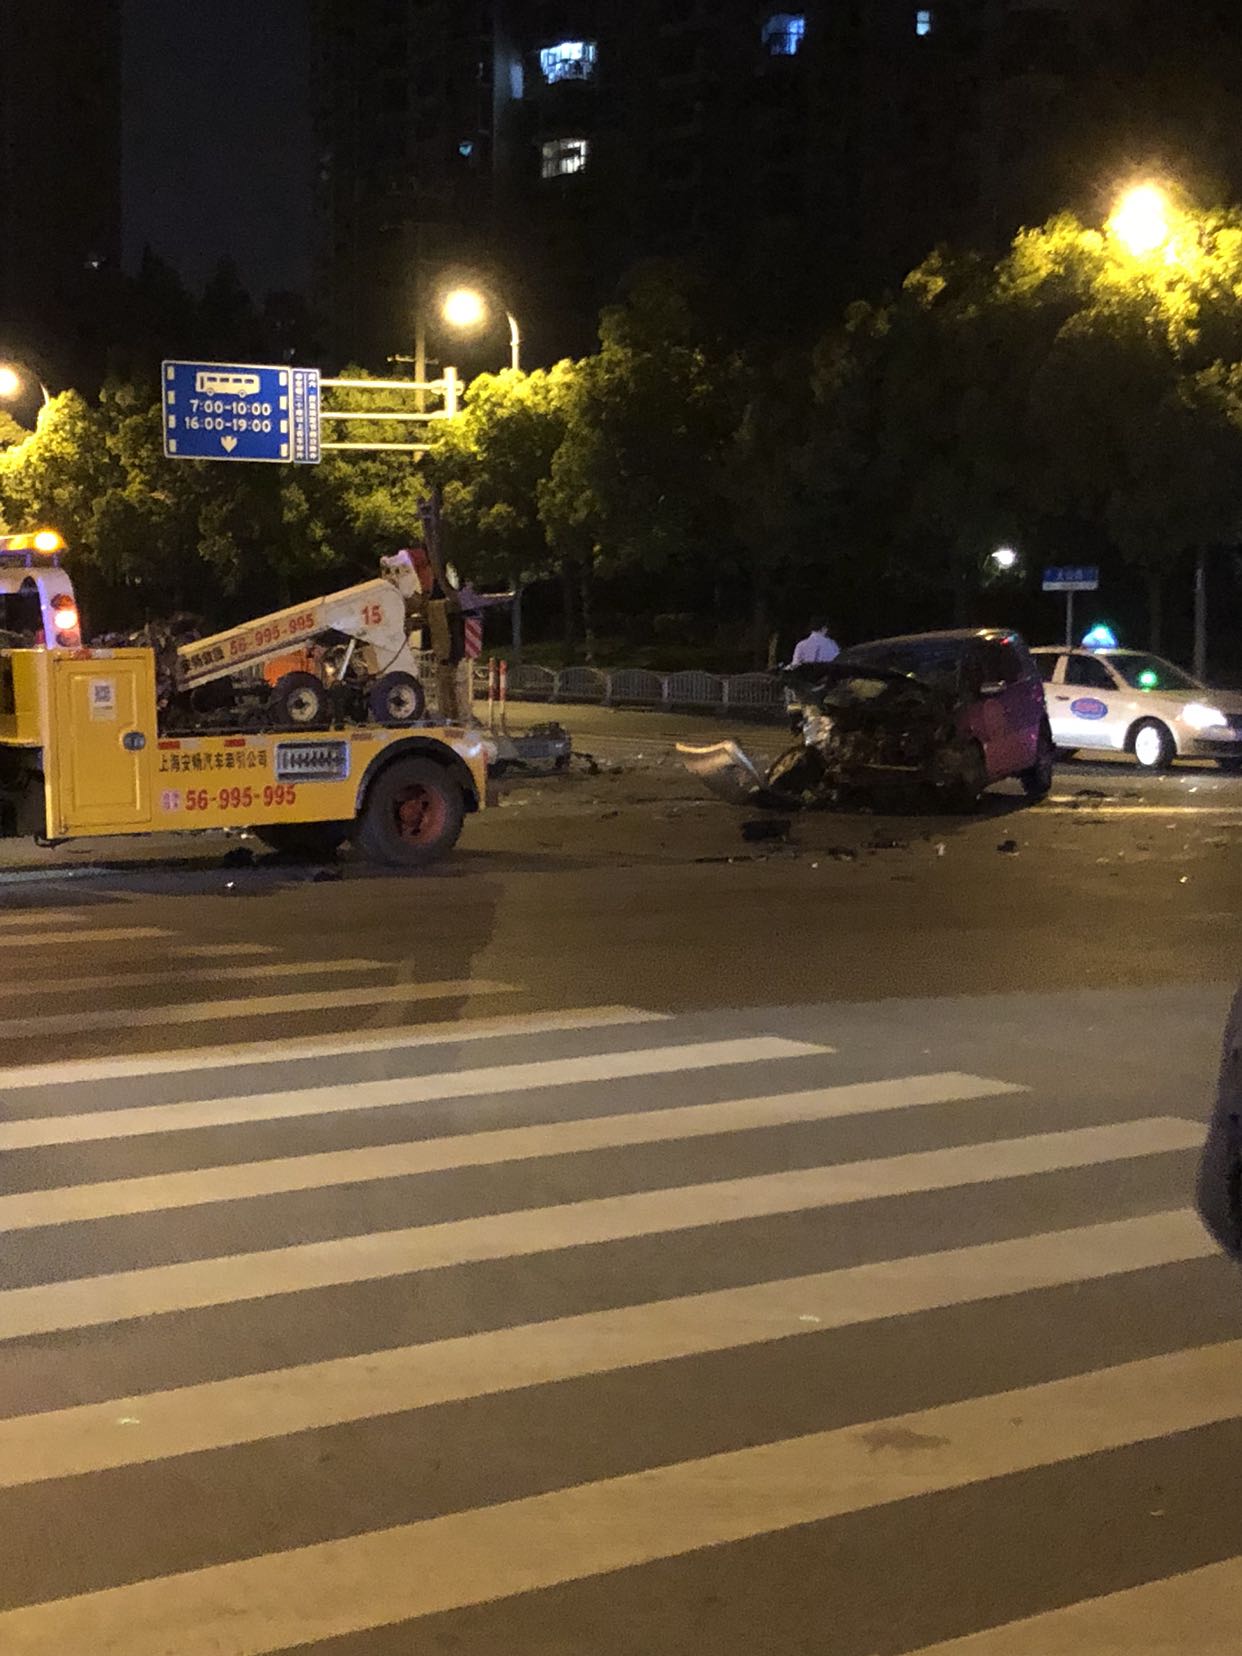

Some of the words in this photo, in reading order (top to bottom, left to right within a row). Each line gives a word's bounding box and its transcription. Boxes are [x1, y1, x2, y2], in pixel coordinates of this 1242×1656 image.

[190, 399, 272, 416] 7:00-10:00
[185, 416, 272, 433] 16:00-19:00
[362, 605, 383, 626] 15
[185, 784, 297, 811] 56-995-995
